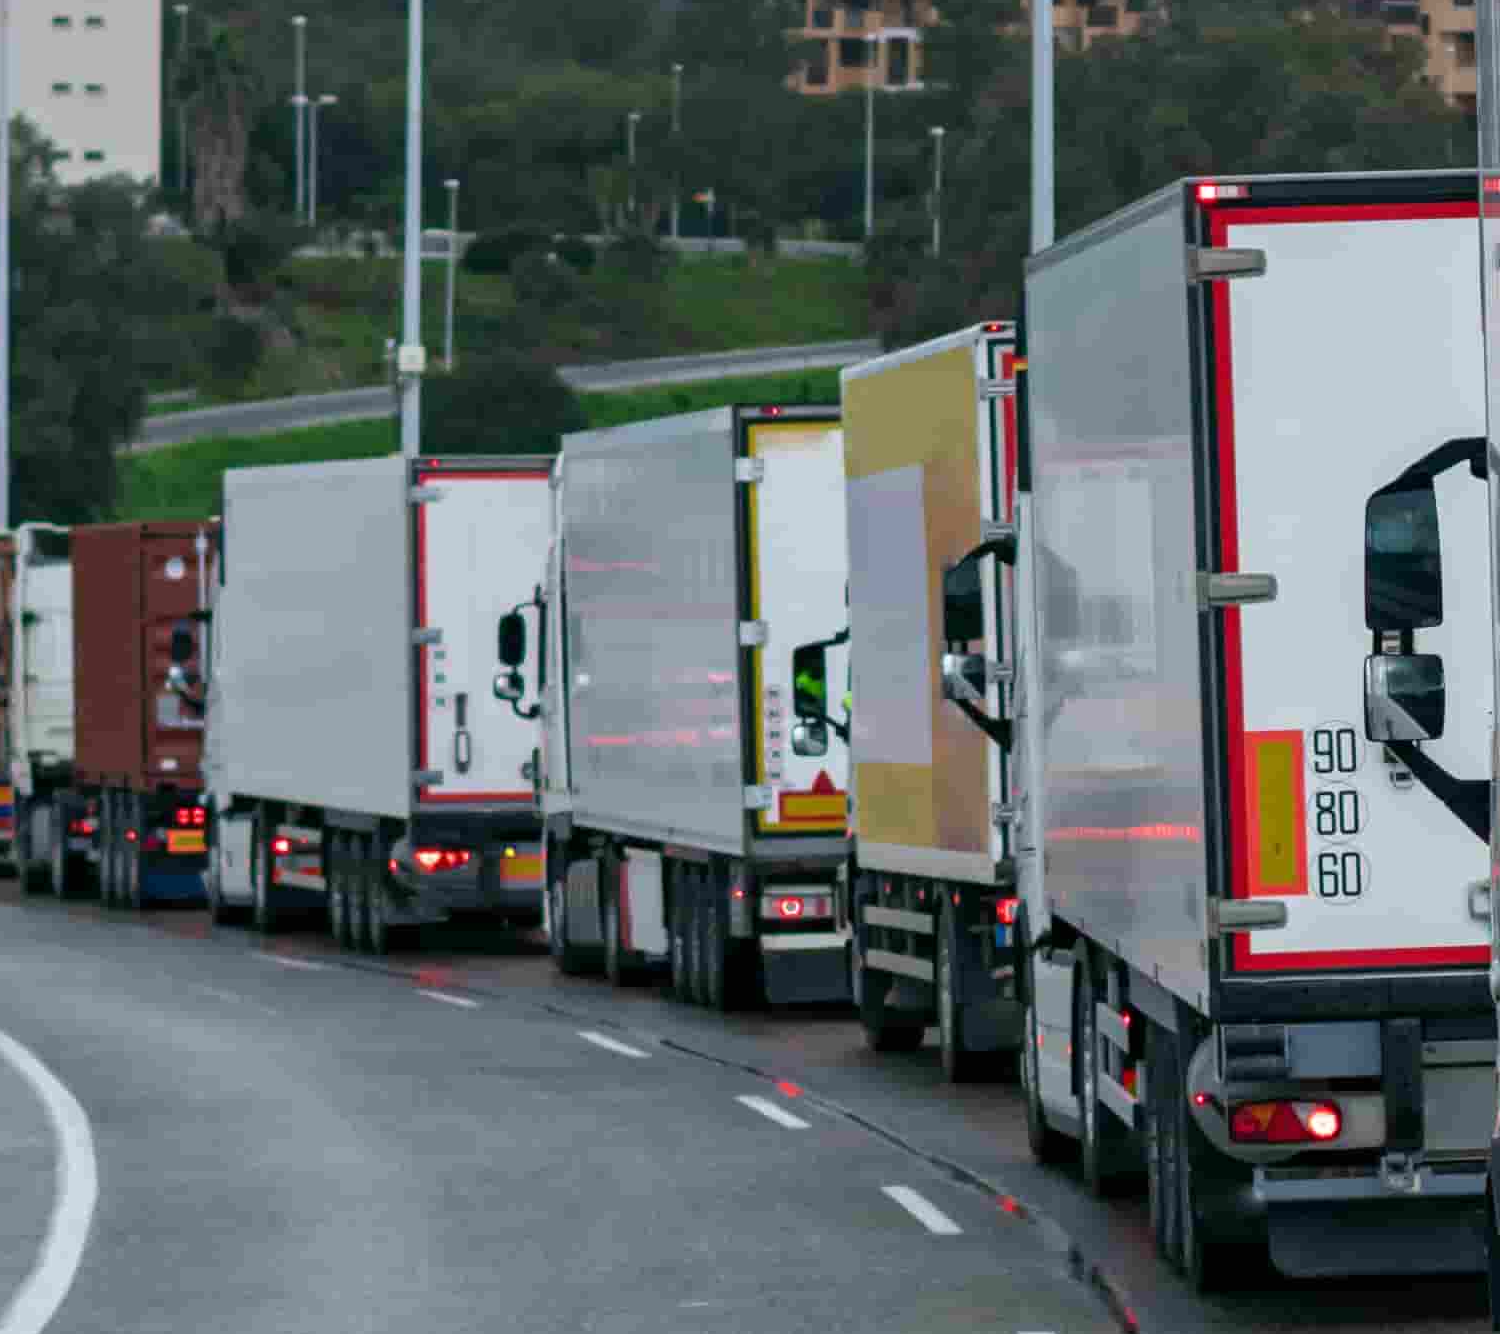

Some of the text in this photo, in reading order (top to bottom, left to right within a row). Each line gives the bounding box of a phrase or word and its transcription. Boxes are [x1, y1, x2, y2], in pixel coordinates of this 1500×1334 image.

[1313, 728, 1357, 773] 90
[1315, 790, 1359, 835] 80
[1318, 852, 1362, 897] 60
